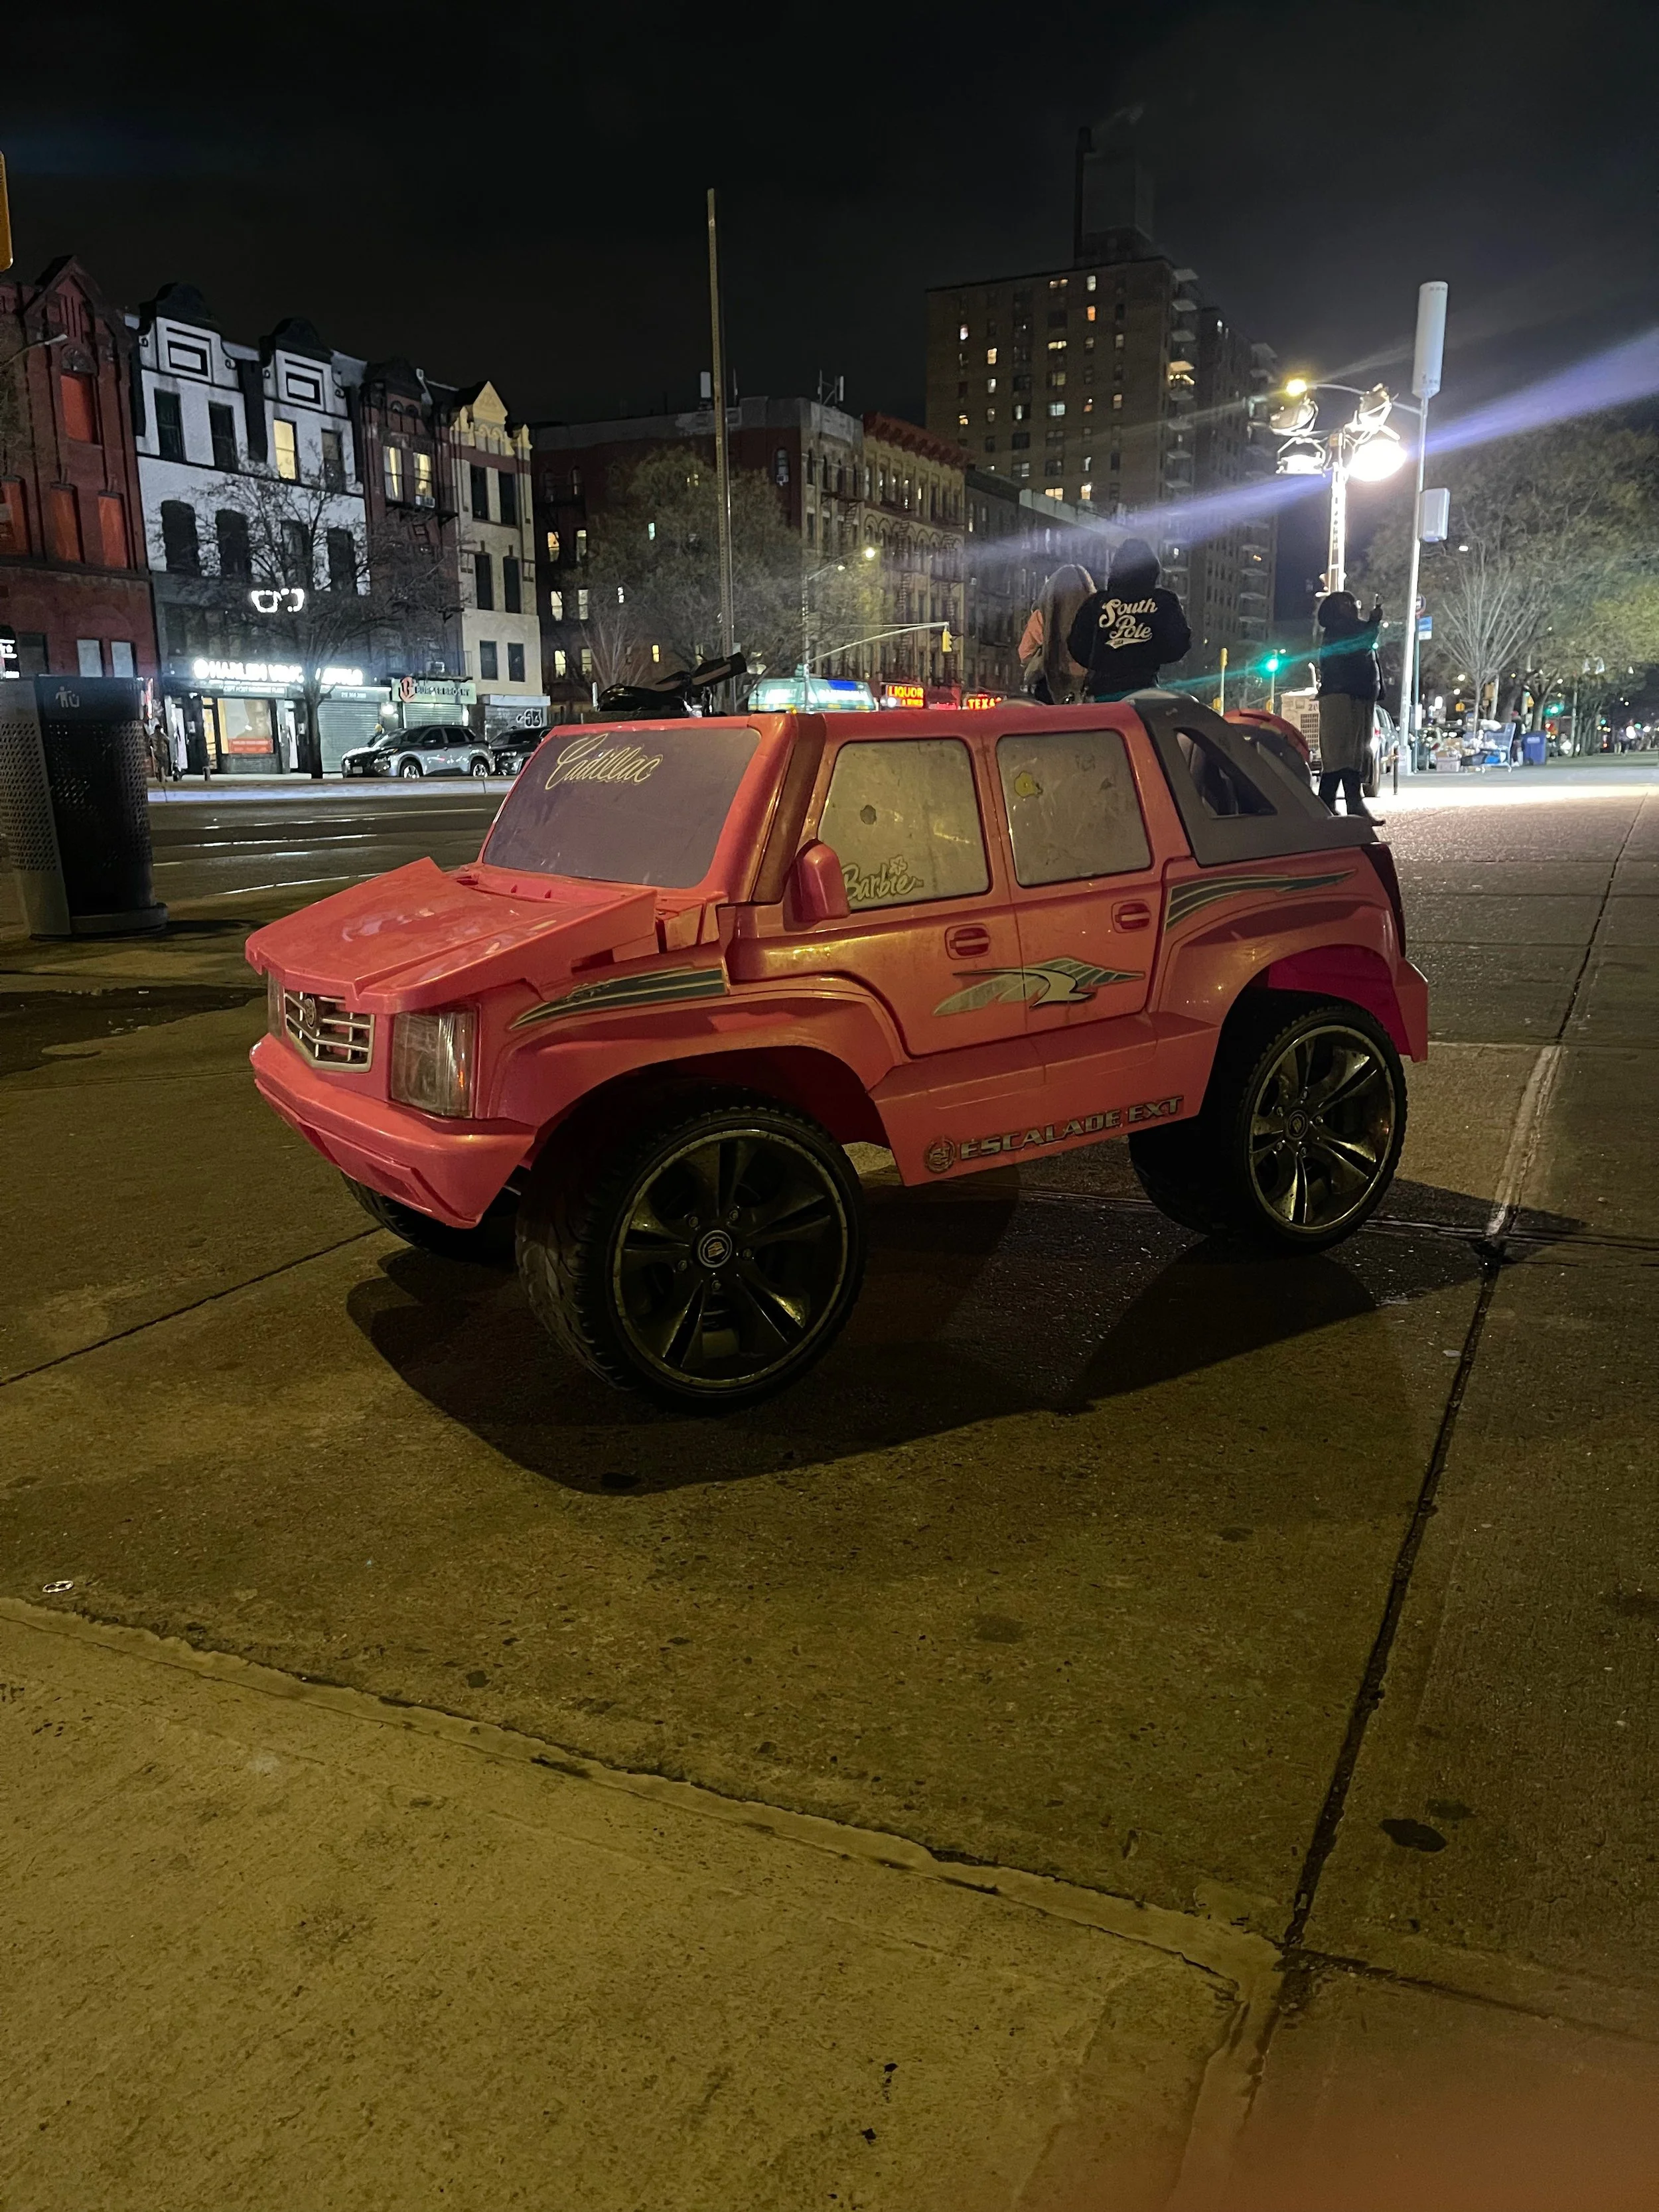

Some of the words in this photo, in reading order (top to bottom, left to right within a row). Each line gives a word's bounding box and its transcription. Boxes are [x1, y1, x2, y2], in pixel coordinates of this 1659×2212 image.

[1099, 598, 1158, 628] South
[1109, 615, 1153, 639] Pole
[889, 686, 924, 698] LIQUOR
[545, 733, 662, 790] Cadillac
[841, 855, 916, 901] Barbie
[960, 1109, 1122, 1160] ESCALADE
[1128, 1096, 1184, 1123] EXT
